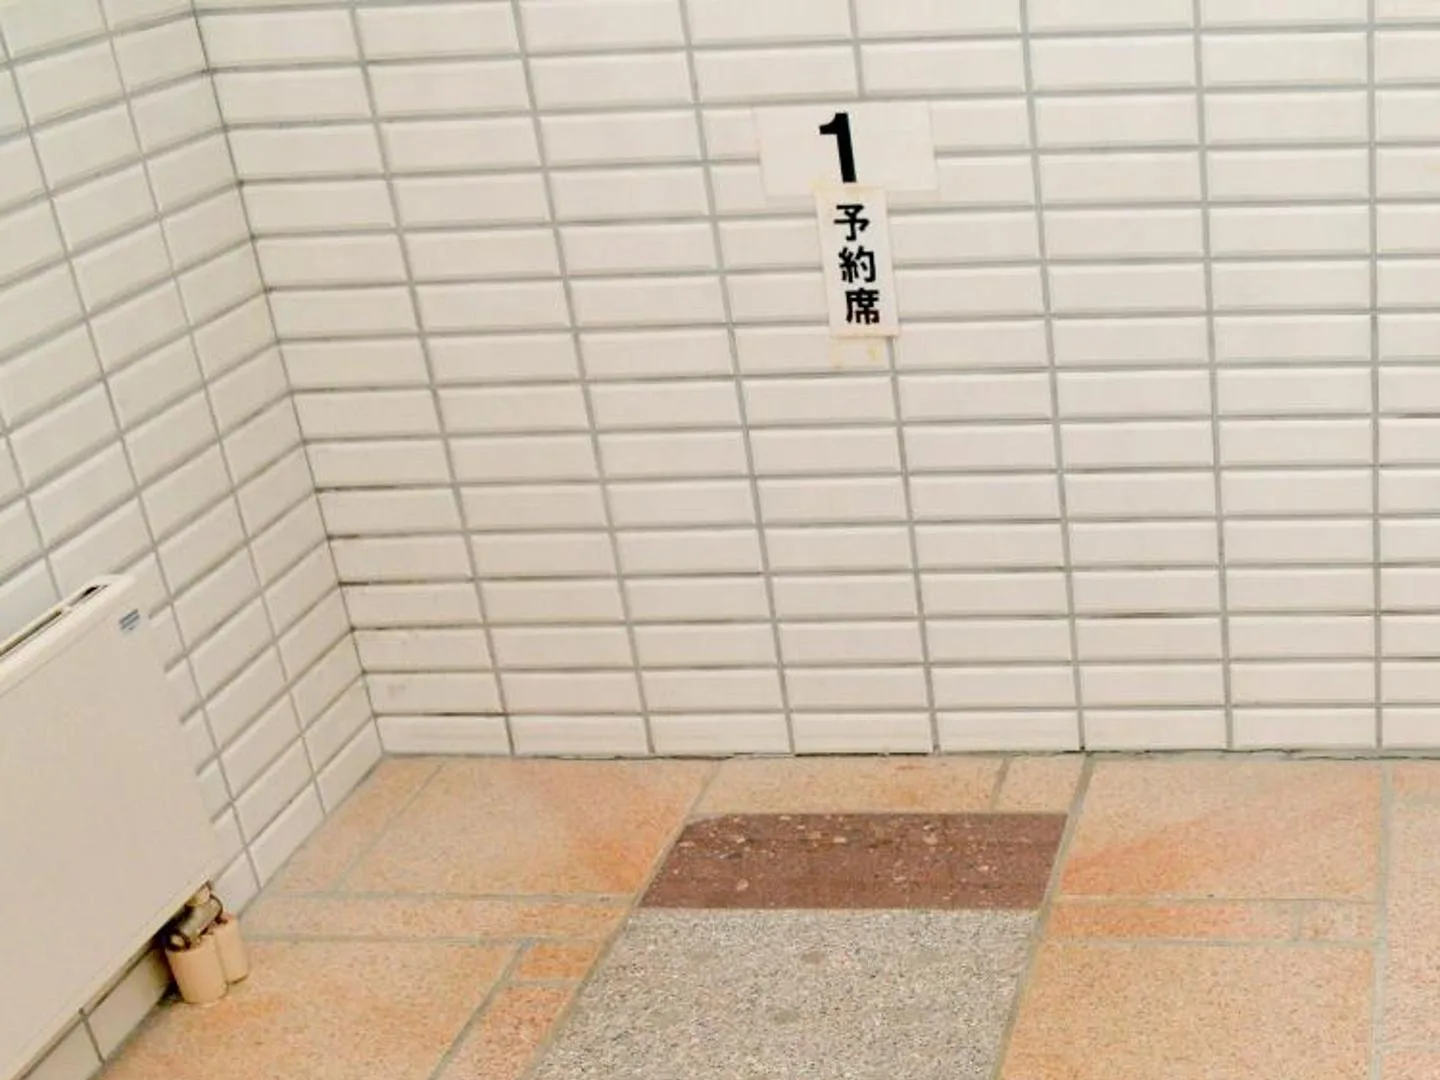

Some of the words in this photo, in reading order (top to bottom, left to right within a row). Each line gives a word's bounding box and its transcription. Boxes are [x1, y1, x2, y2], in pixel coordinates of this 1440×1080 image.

[819, 112, 857, 183] 1
[834, 203, 880, 324] 予約席
